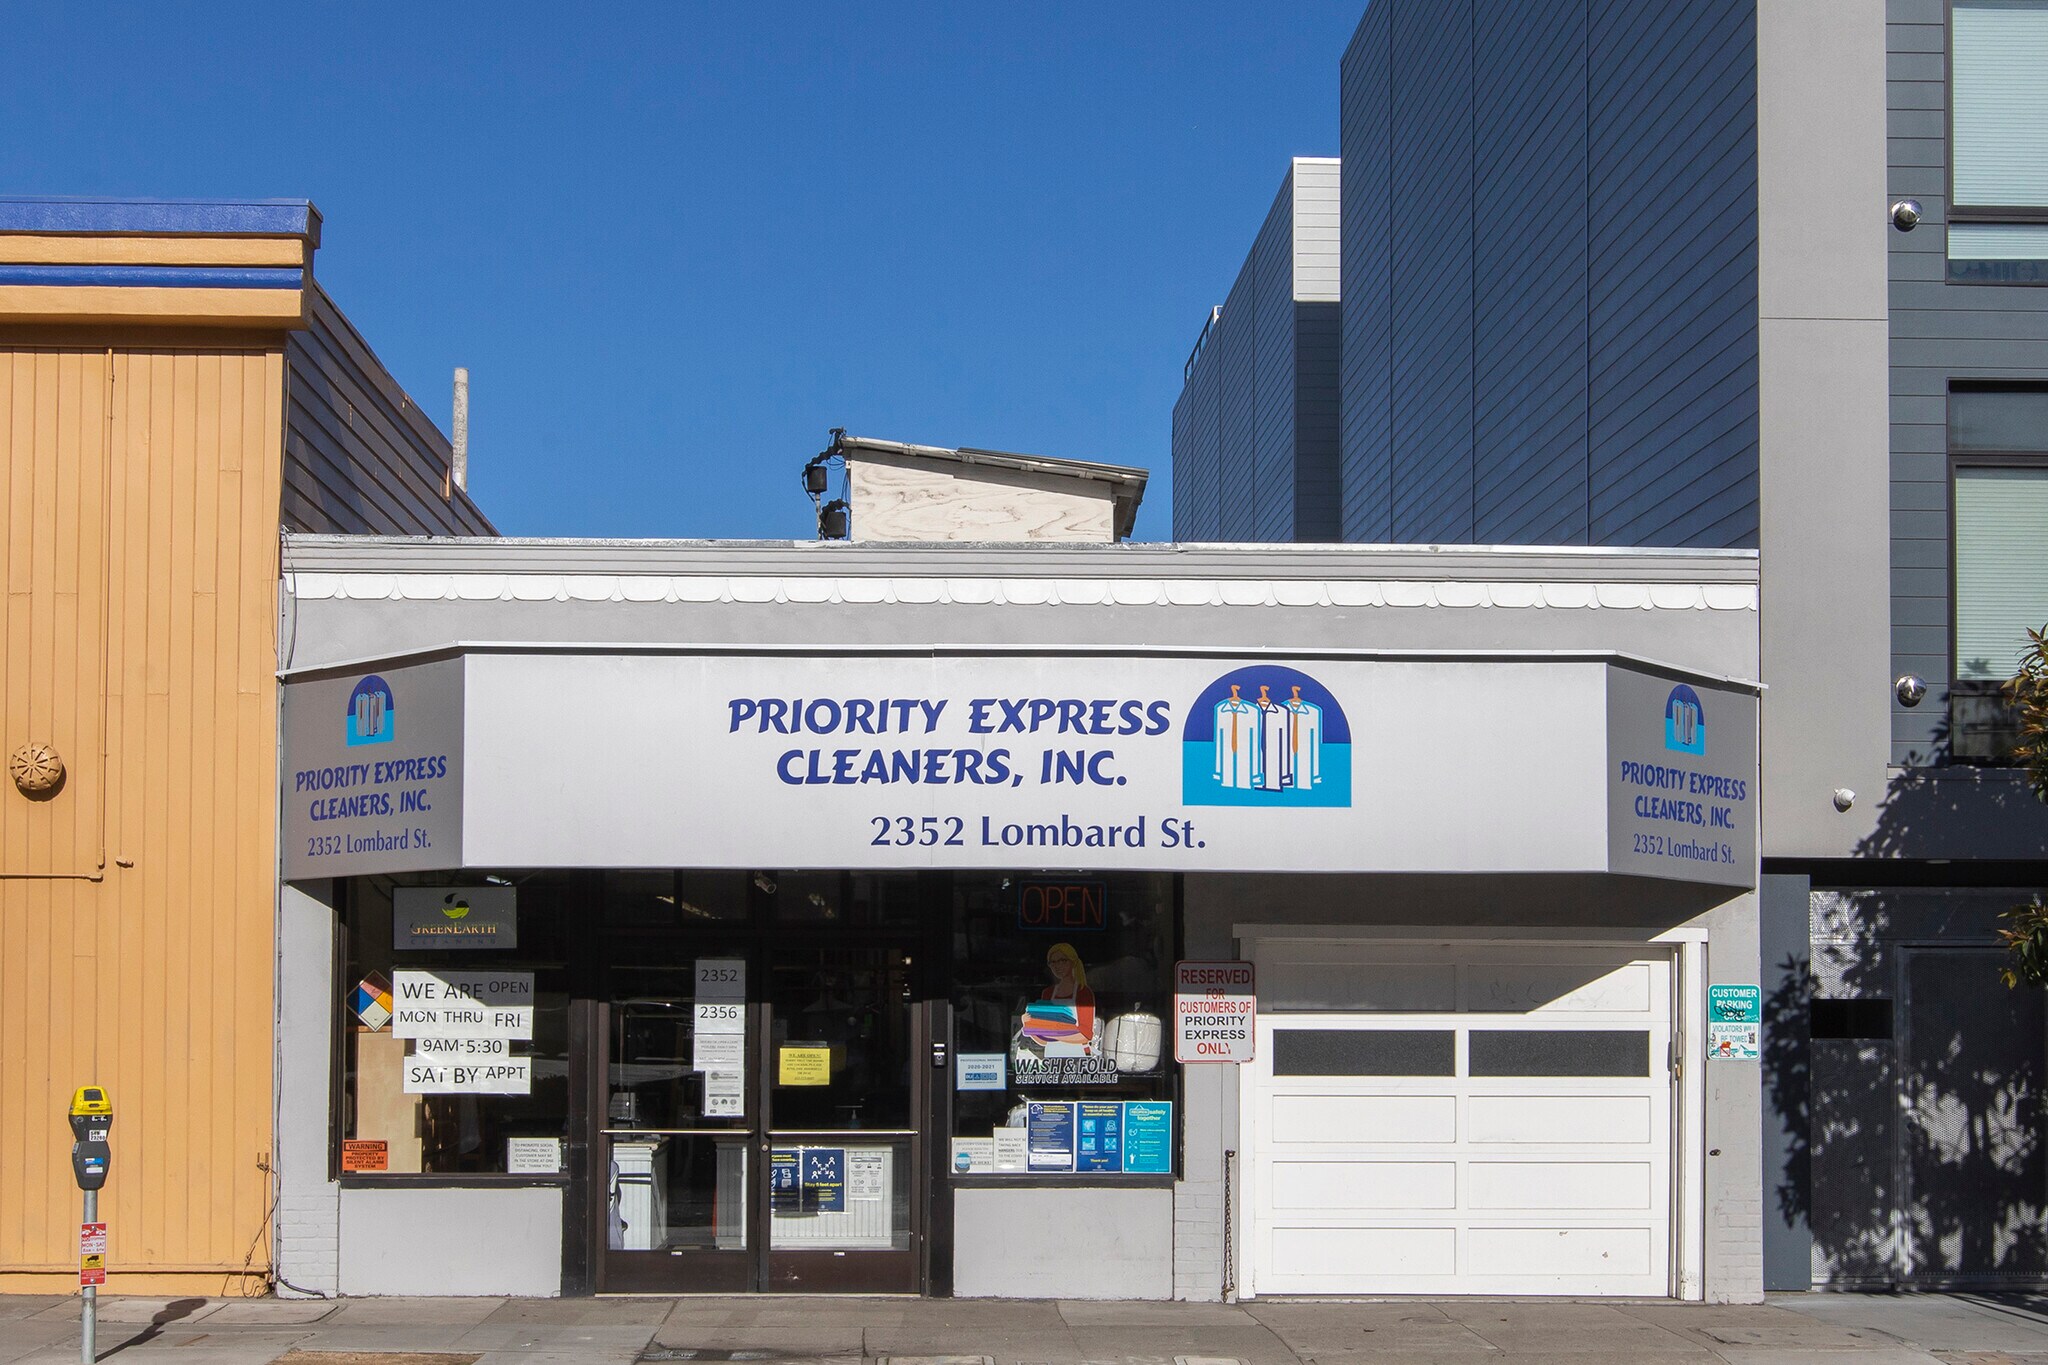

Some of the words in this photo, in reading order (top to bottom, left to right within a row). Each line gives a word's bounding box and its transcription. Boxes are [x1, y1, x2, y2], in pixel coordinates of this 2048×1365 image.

[729, 698, 947, 735] PRIORITY
[969, 698, 1170, 736] EXPRESS
[296, 763, 370, 792] PRIORITY
[374, 755, 447, 784] EXPRESS
[777, 748, 1022, 787] CLEANERS,
[1040, 750, 1127, 786] INC.
[1621, 760, 1686, 791] PRIORITY
[1689, 771, 1746, 801] EXPRESS
[310, 792, 394, 821] CLEANERS,
[400, 788, 432, 813] INC.
[1635, 795, 1706, 828] CLEANERS,
[1710, 806, 1735, 829] INC.
[870, 816, 964, 846] 2352
[981, 814, 1146, 848] Lombard
[1161, 817, 1206, 848] St.
[307, 835, 341, 856] 2352
[347, 828, 409, 853] Lombard
[413, 828, 431, 849] St.
[1633, 834, 1663, 855] 2352
[1667, 837, 1718, 863] Lombard
[1721, 844, 1735, 864] St.
[1022, 886, 1102, 925] OPEN
[701, 969, 737, 982] 2352
[1181, 969, 1250, 984] RESERVED
[402, 983, 435, 999] WE
[444, 983, 483, 999] ARE
[488, 981, 529, 993] OPEN
[1206, 988, 1225, 1000] FOR
[1711, 988, 1757, 998] CUSTOMER
[700, 1006, 737, 1019] 2356
[1180, 1001, 1237, 1013] CUSTOMERS
[1238, 1001, 1251, 1013] OF
[1716, 1000, 1753, 1009] PARKING
[400, 1011, 437, 1023] MON
[444, 1011, 483, 1023] THRU
[495, 1013, 521, 1027] FRI
[1185, 1016, 1246, 1026] PRIORITY
[1185, 1029, 1246, 1040] EXPRESS
[1015, 1058, 1061, 1074] WASH
[1063, 1058, 1076, 1074] &
[1078, 1058, 1118, 1074] FOLD
[411, 1067, 447, 1083] SAT
[454, 1067, 479, 1083] BY
[485, 1066, 526, 1079] APPT
[1015, 1074, 1059, 1084] SERVICE
[1061, 1074, 1118, 1084] AVAILABLE
